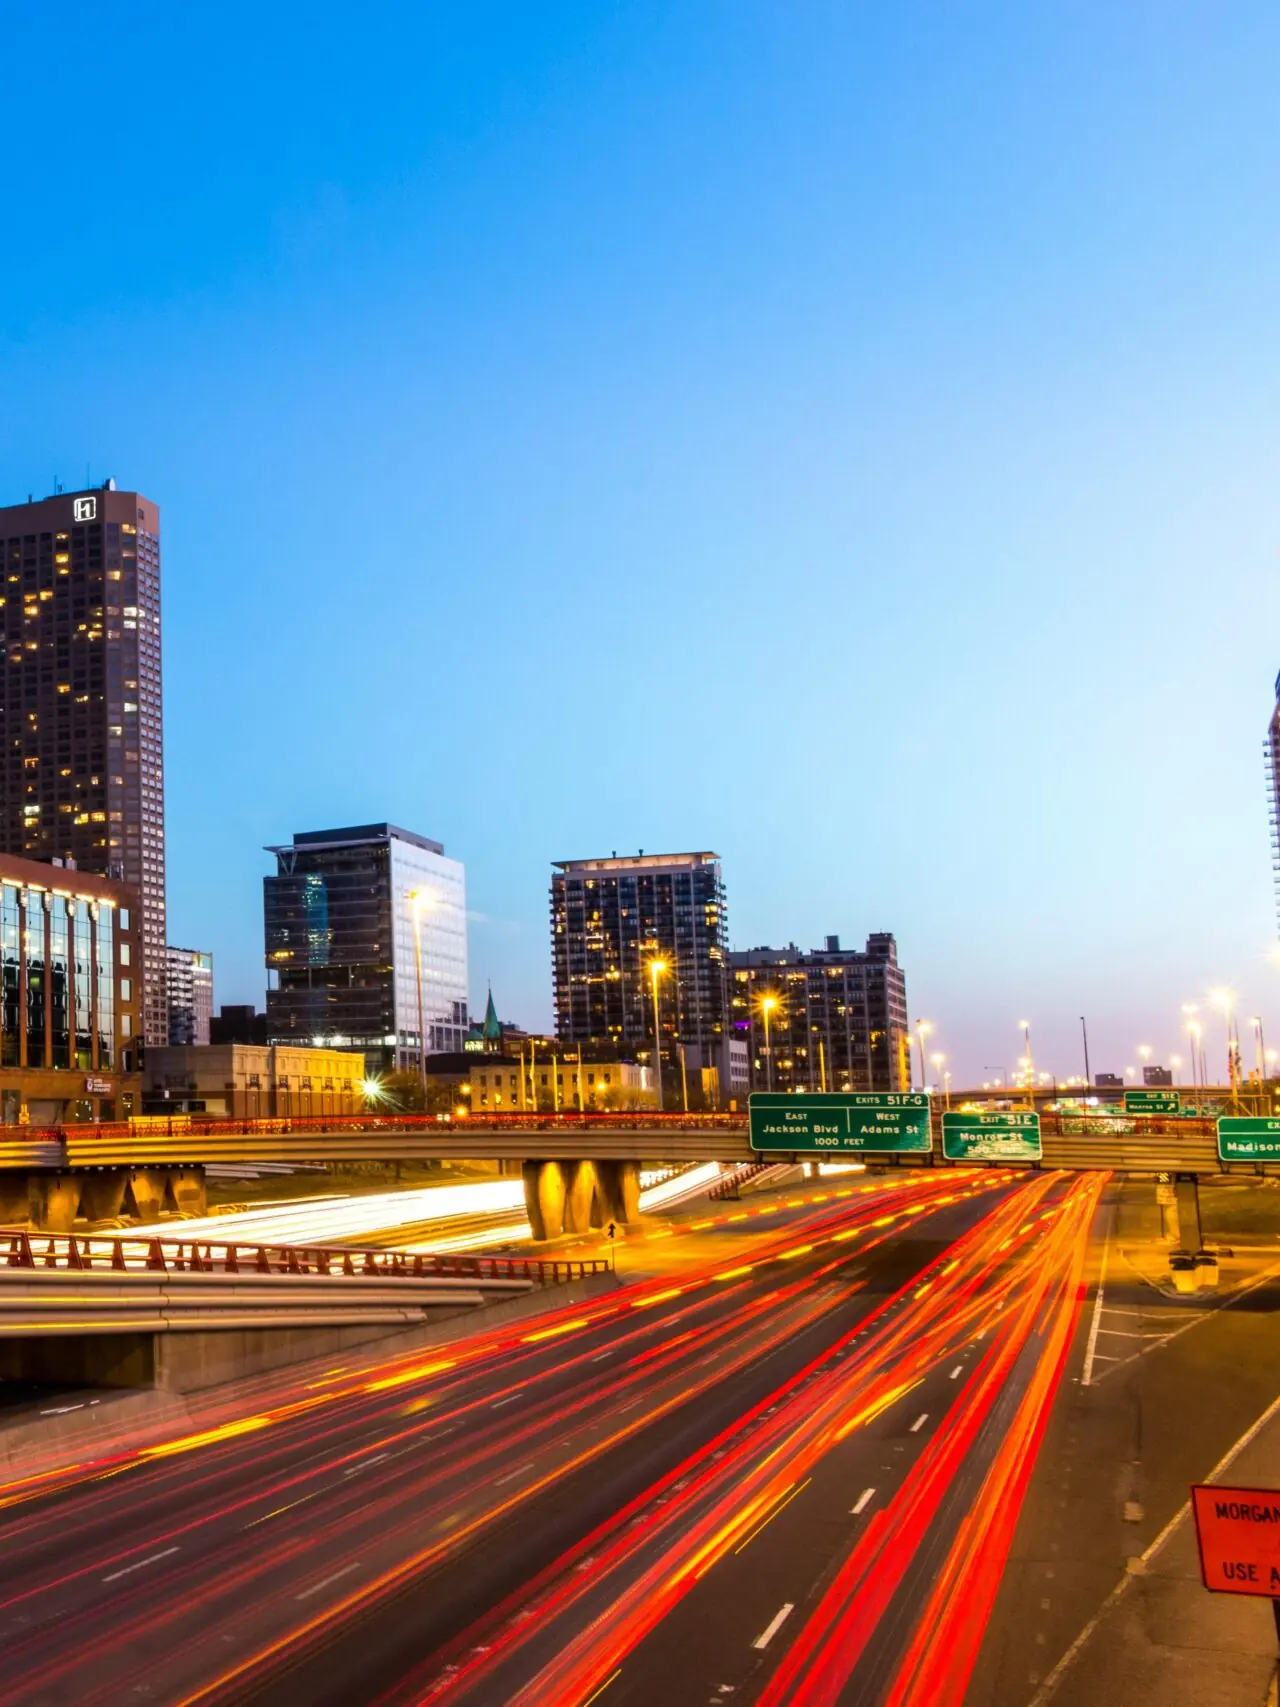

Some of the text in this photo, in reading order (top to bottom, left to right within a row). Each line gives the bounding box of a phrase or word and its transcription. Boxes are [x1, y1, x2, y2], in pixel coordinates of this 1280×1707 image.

[887, 1095, 923, 1105] 51F-G
[785, 1112, 808, 1120] EAST
[876, 1113, 900, 1121] WEST
[980, 1114, 1032, 1125] EXIT 51E
[763, 1125, 839, 1133] Jackson Blvd
[861, 1125, 919, 1134] Adams St
[1010, 1132, 1023, 1141] St
[1227, 1142, 1280, 1152] Madison
[1216, 1503, 1280, 1522] MORGAN
[1223, 1562, 1258, 1581] USE
